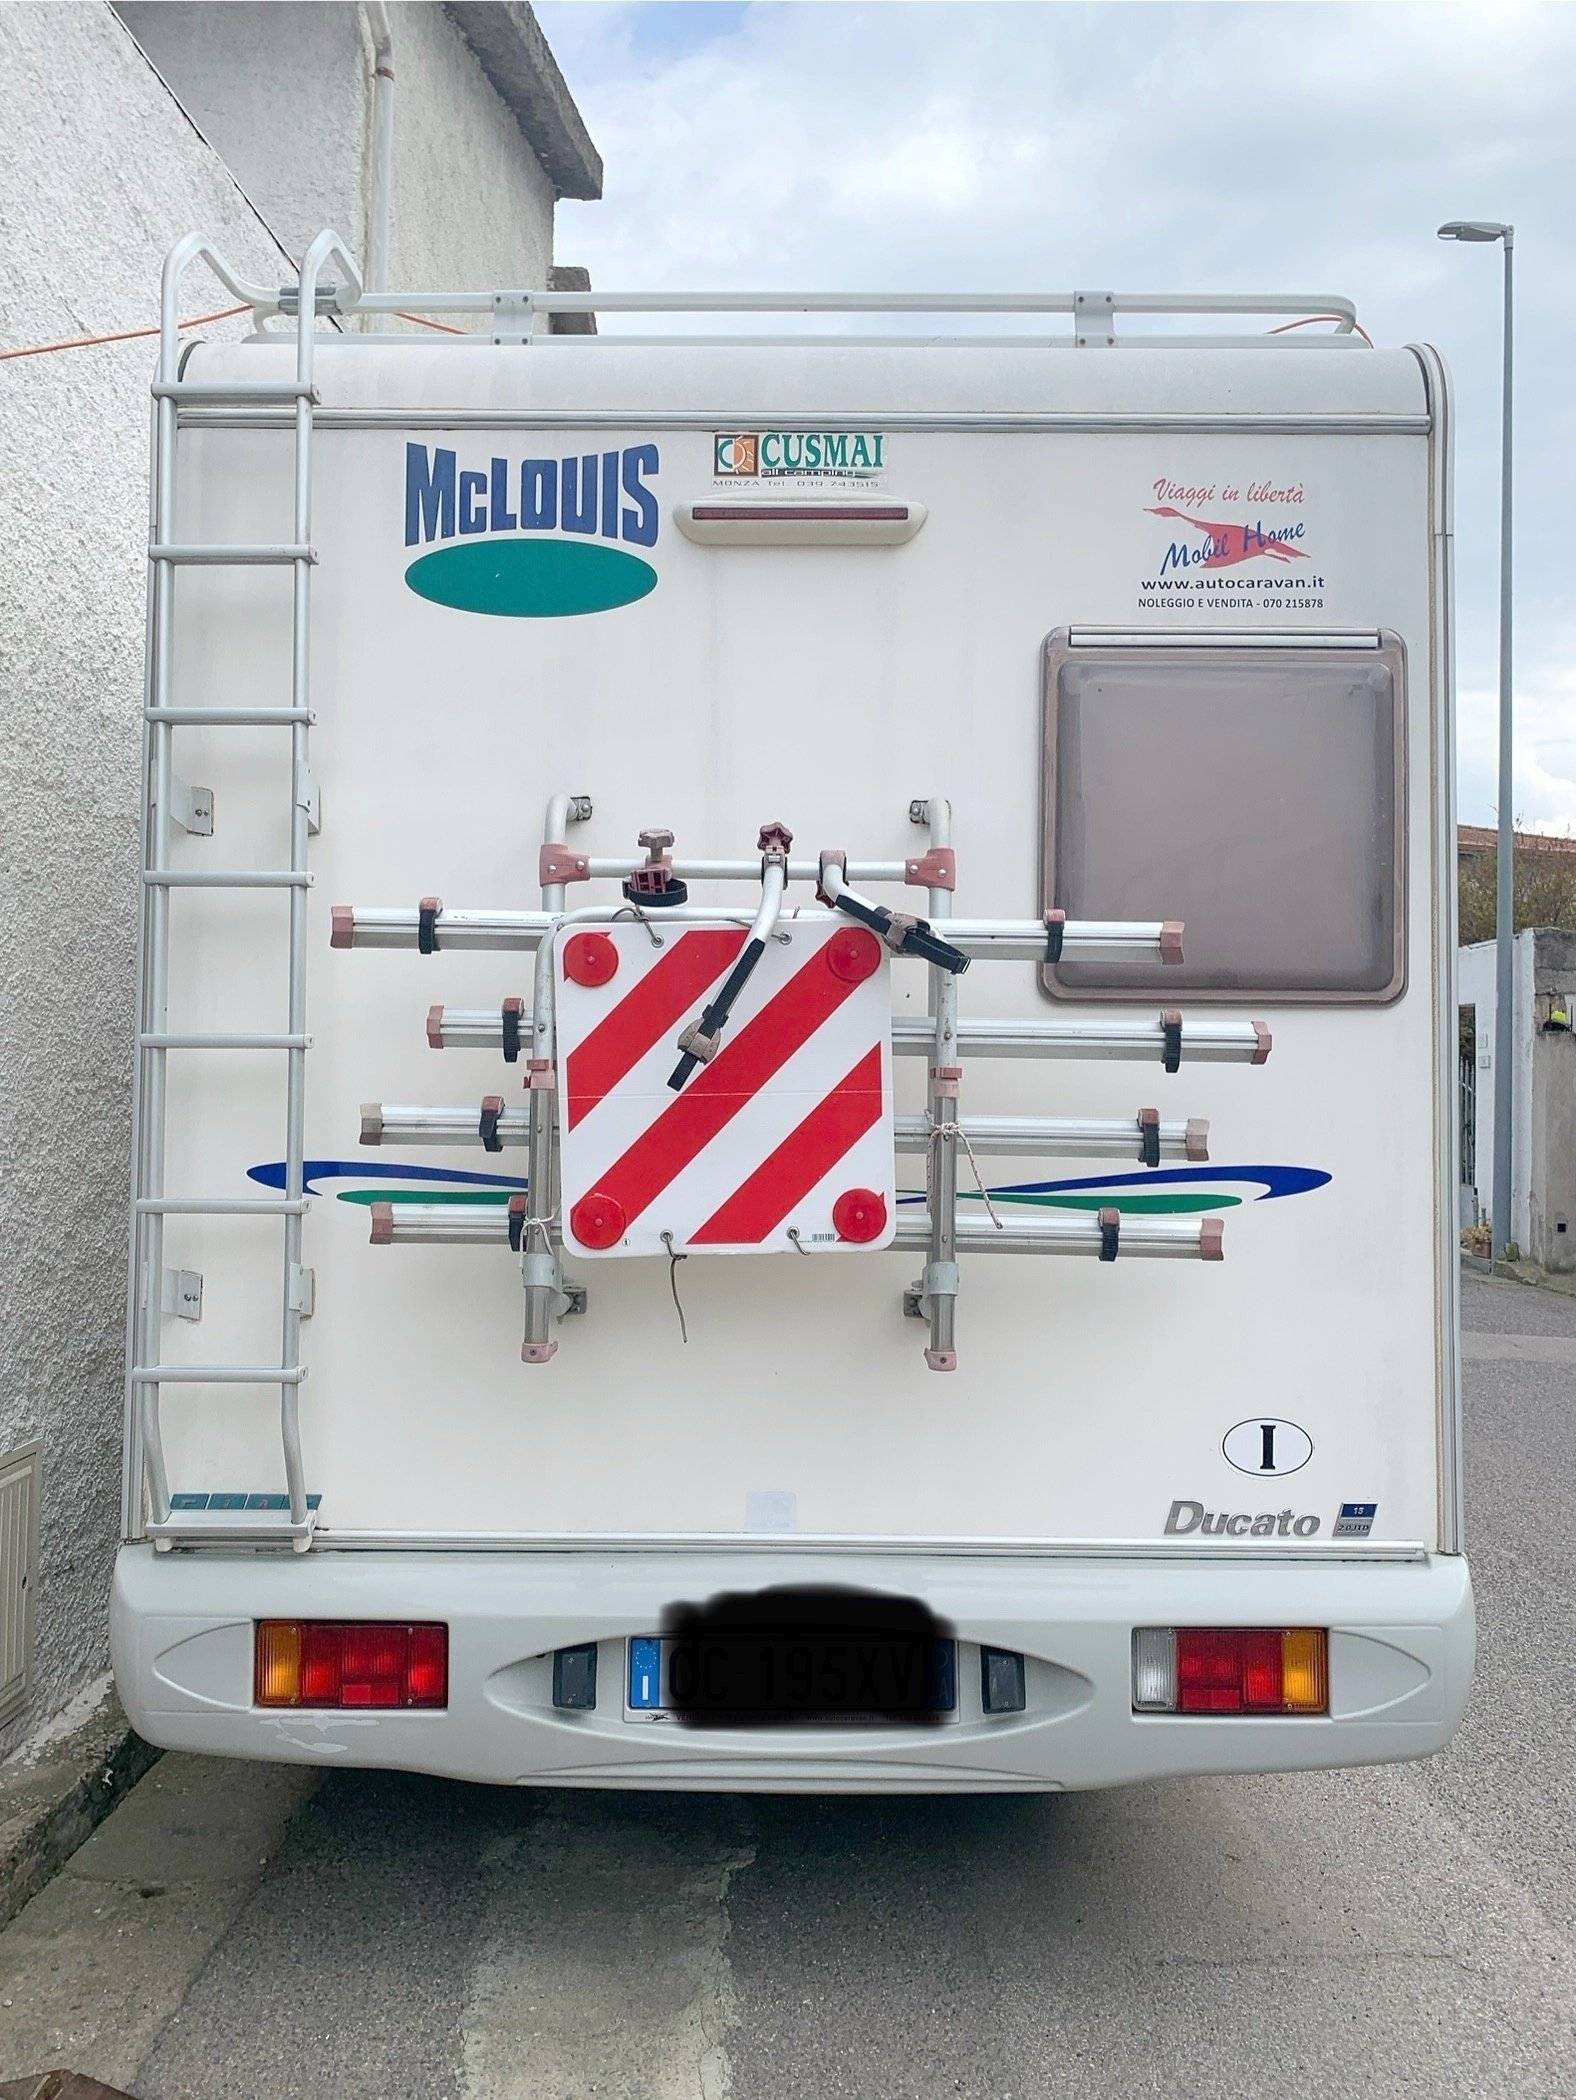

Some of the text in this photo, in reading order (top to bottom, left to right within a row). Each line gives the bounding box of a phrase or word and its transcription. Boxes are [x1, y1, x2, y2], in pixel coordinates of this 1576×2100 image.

[761, 434, 883, 468] CUSMAI
[784, 468, 856, 478] camping
[405, 441, 659, 548] McLOUIS
[1153, 478, 1305, 508] Viaggi in libertà
[1160, 520, 1306, 576] Mobil Home
[1141, 575, 1325, 590] www.autocaravan.it
[1138, 598, 1195, 609] NOLEGGIO
[1198, 598, 1204, 608] E
[1207, 598, 1254, 608] VENDITA
[1263, 599, 1283, 609] 070
[1285, 599, 1324, 609] 215878
[1260, 1425, 1276, 1470] I
[1164, 1500, 1321, 1537] Ducato
